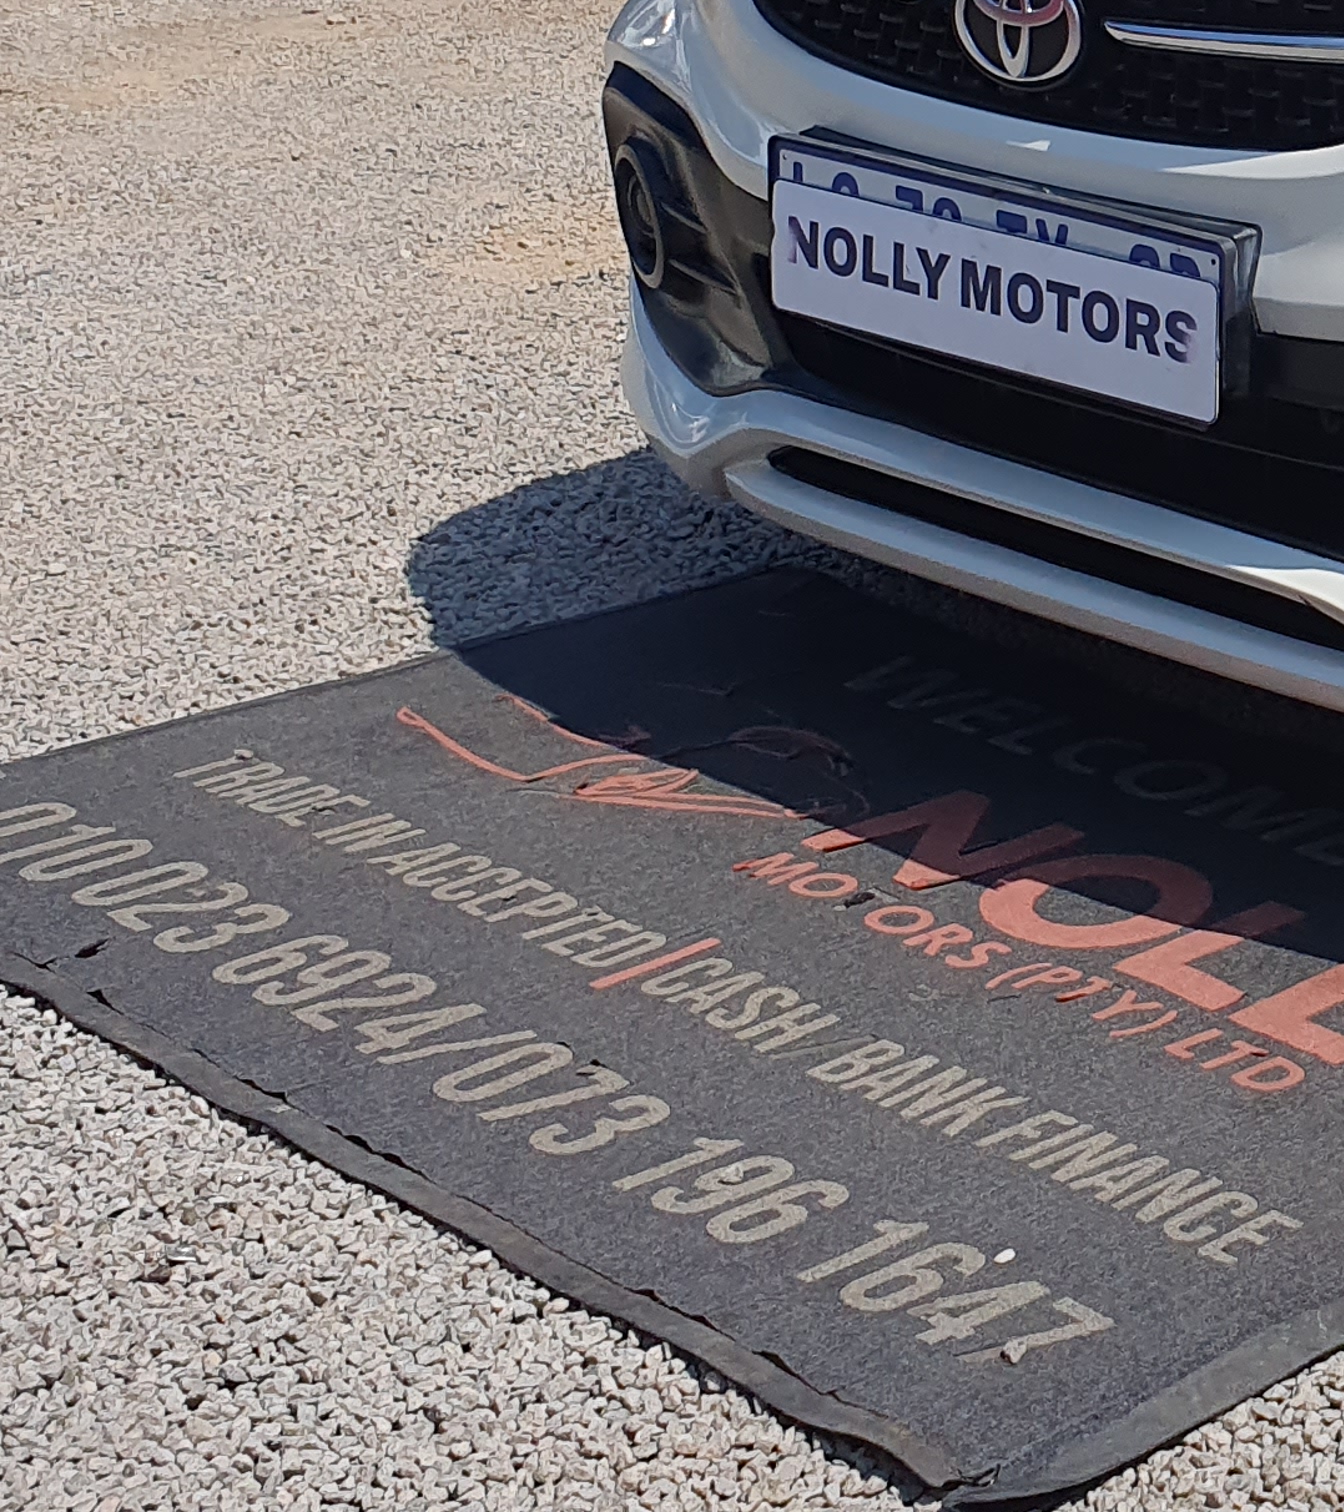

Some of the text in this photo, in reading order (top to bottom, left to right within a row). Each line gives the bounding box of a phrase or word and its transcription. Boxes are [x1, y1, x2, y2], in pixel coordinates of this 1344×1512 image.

[787, 215, 1198, 363] NOLLY MOTORS
[172, 749, 371, 828] TRADE
[311, 812, 427, 853] IN
[975, 1109, 1303, 1267] FINANCE
[731, 851, 1013, 969] MOORS
[1163, 1027, 1306, 1093] LTD
[610, 1135, 850, 1245] 196
[796, 1218, 1116, 1365] 1647
